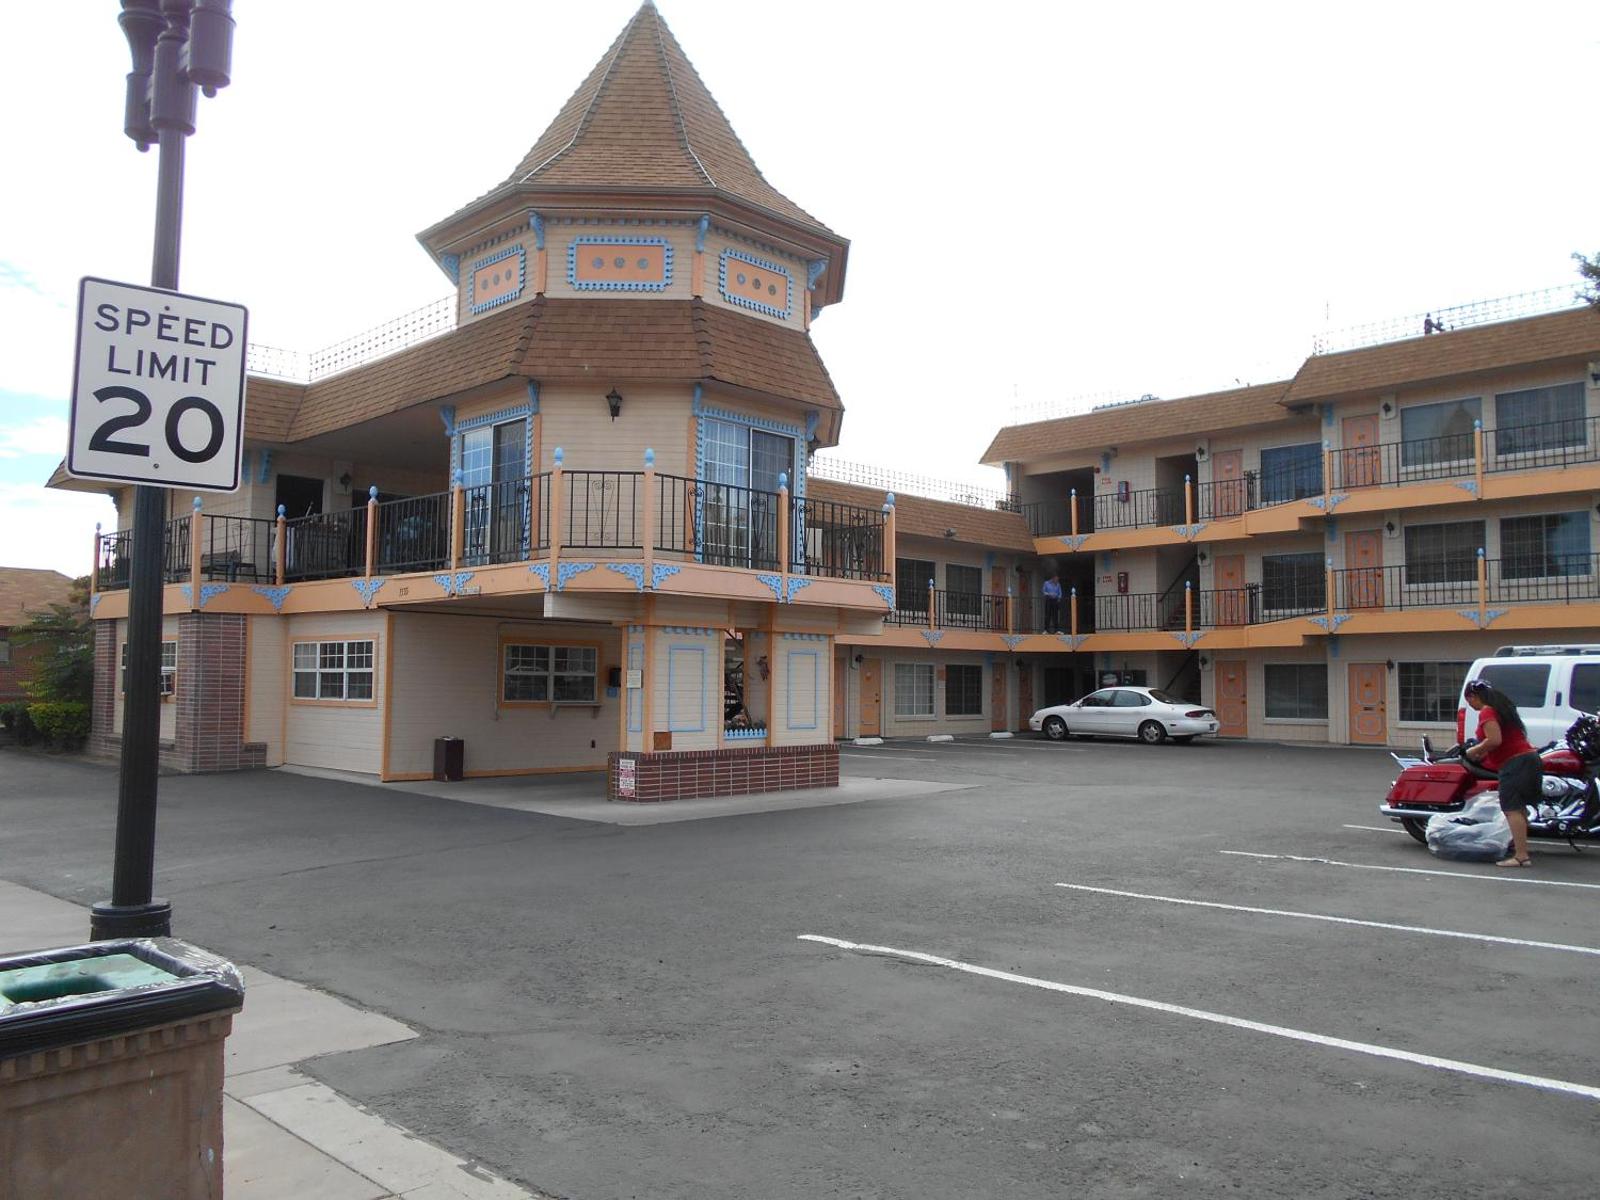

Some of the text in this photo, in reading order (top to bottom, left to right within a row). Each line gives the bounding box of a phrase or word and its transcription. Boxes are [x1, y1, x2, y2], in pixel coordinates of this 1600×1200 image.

[94, 303, 234, 350] SPEED
[107, 345, 216, 386] LIMIT
[88, 385, 225, 464] 20
